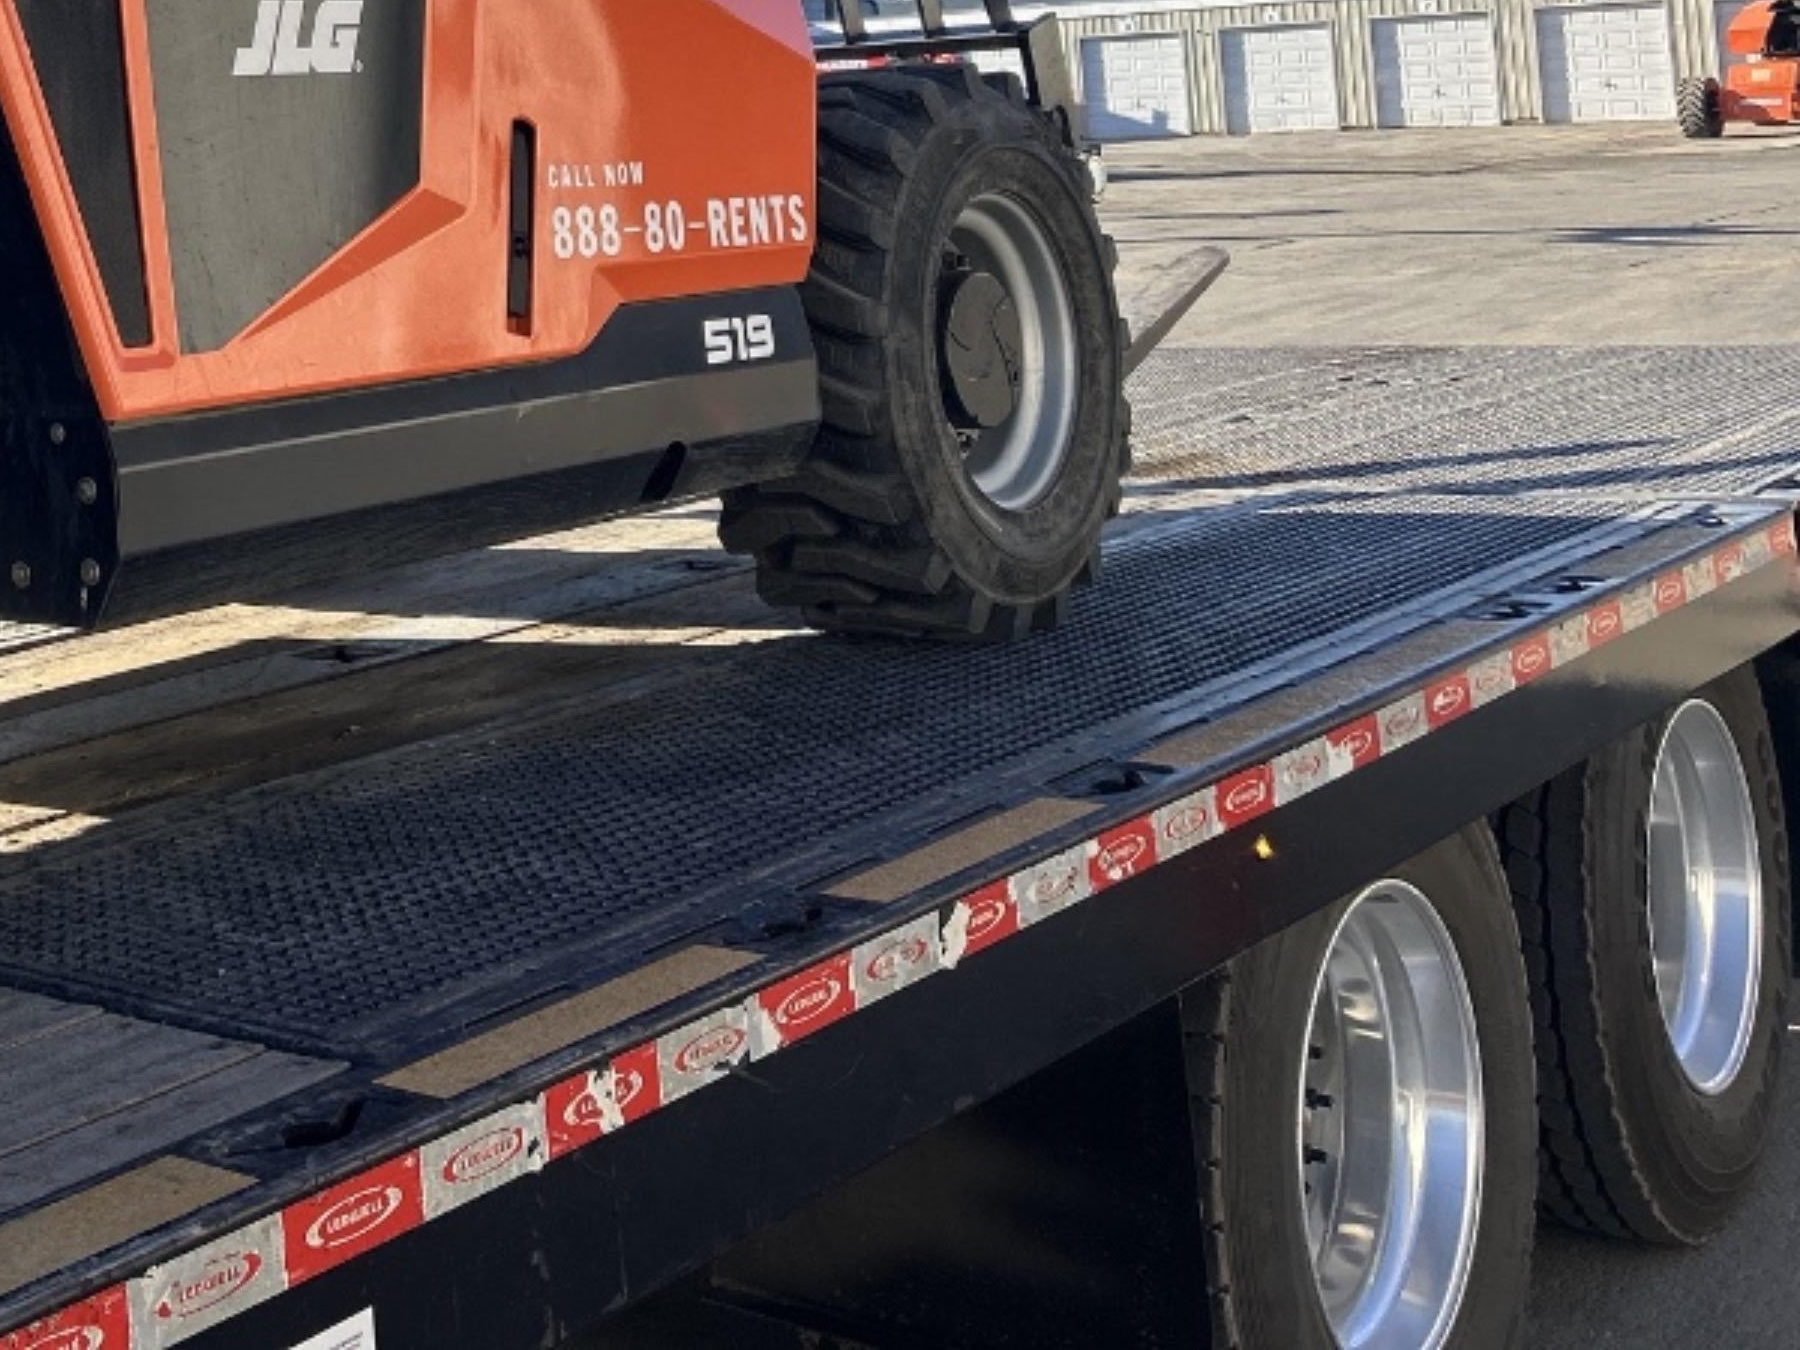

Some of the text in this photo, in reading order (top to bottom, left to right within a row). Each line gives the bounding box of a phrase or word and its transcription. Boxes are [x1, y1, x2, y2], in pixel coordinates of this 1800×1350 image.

[232, 0, 364, 75] JLG
[548, 161, 644, 188] CALL NOW
[552, 193, 808, 259] 888-80-RENTS
[703, 313, 776, 365] 519
